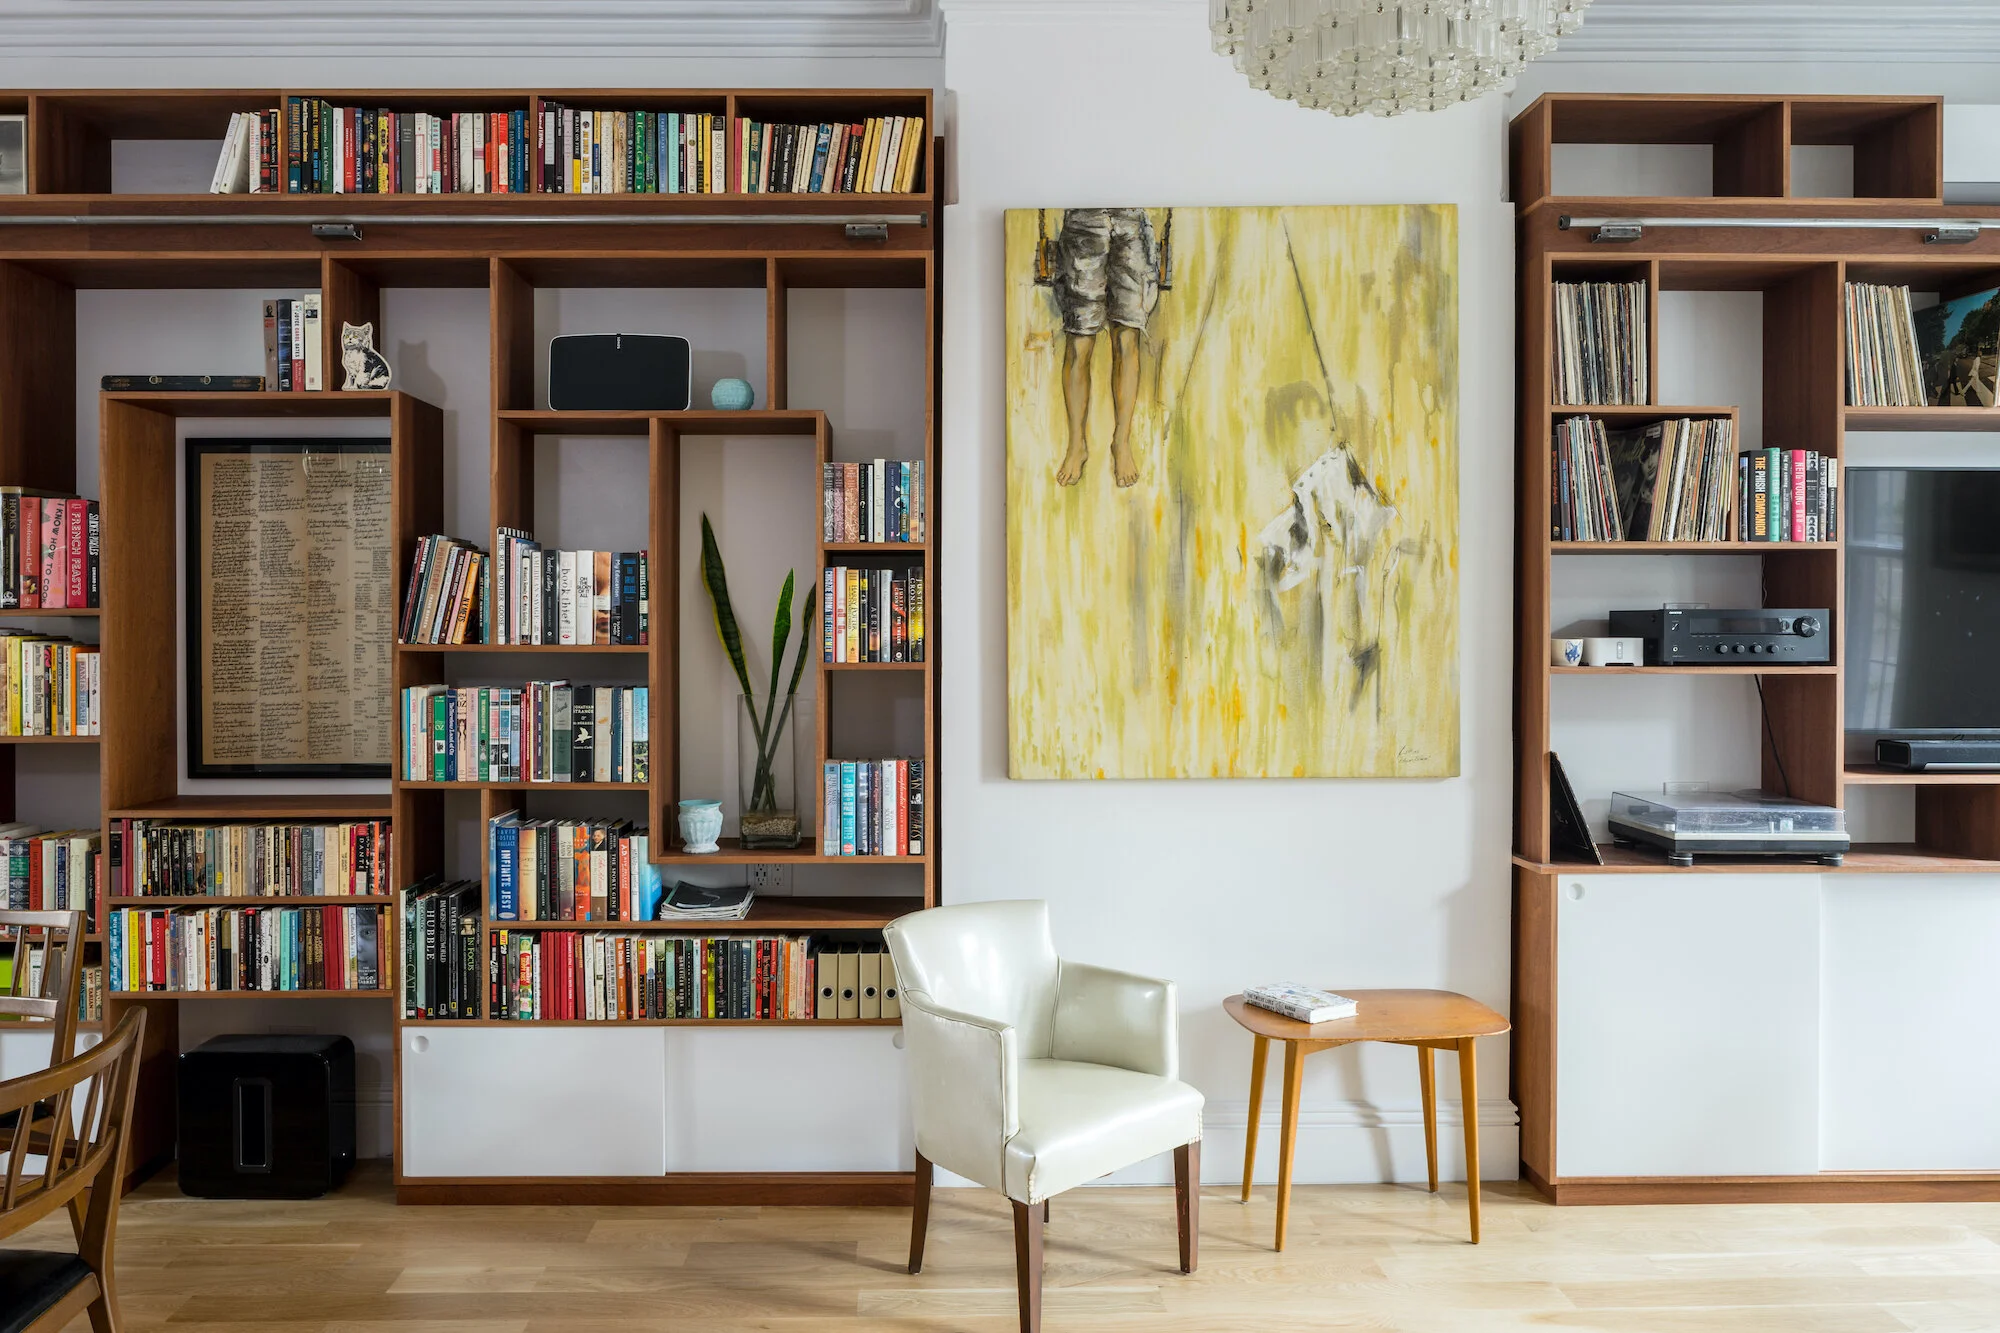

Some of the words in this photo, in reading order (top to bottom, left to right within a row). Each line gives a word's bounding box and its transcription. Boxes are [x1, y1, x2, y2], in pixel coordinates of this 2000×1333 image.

[847, 157, 856, 191] SEABISCUIT
[1755, 456, 1765, 470] THE
[1819, 458, 1827, 476] LET'S
[1755, 471, 1765, 492] PHISH
[1795, 481, 1804, 505] YOUNG
[1819, 486, 1827, 510] CRAZY
[9, 499, 17, 530] HOOKS
[52, 508, 63, 536] KNOW
[1755, 493, 1765, 535] COMPANION
[71, 513, 81, 554] FRENCH
[48, 538, 57, 560] HOW
[45, 563, 53, 577] TO
[71, 558, 81, 596] FEASTS
[431, 547, 444, 592] POSTSECRET
[614, 560, 621, 569] My
[41, 578, 50, 604] COOK
[561, 568, 570, 595] book
[561, 598, 570, 624] thief
[911, 763, 921, 789] SUSAN
[911, 811, 921, 838] ISAACS
[501, 850, 511, 887] INFINITE
[501, 890, 512, 909] JEST
[406, 964, 415, 992] CAT
